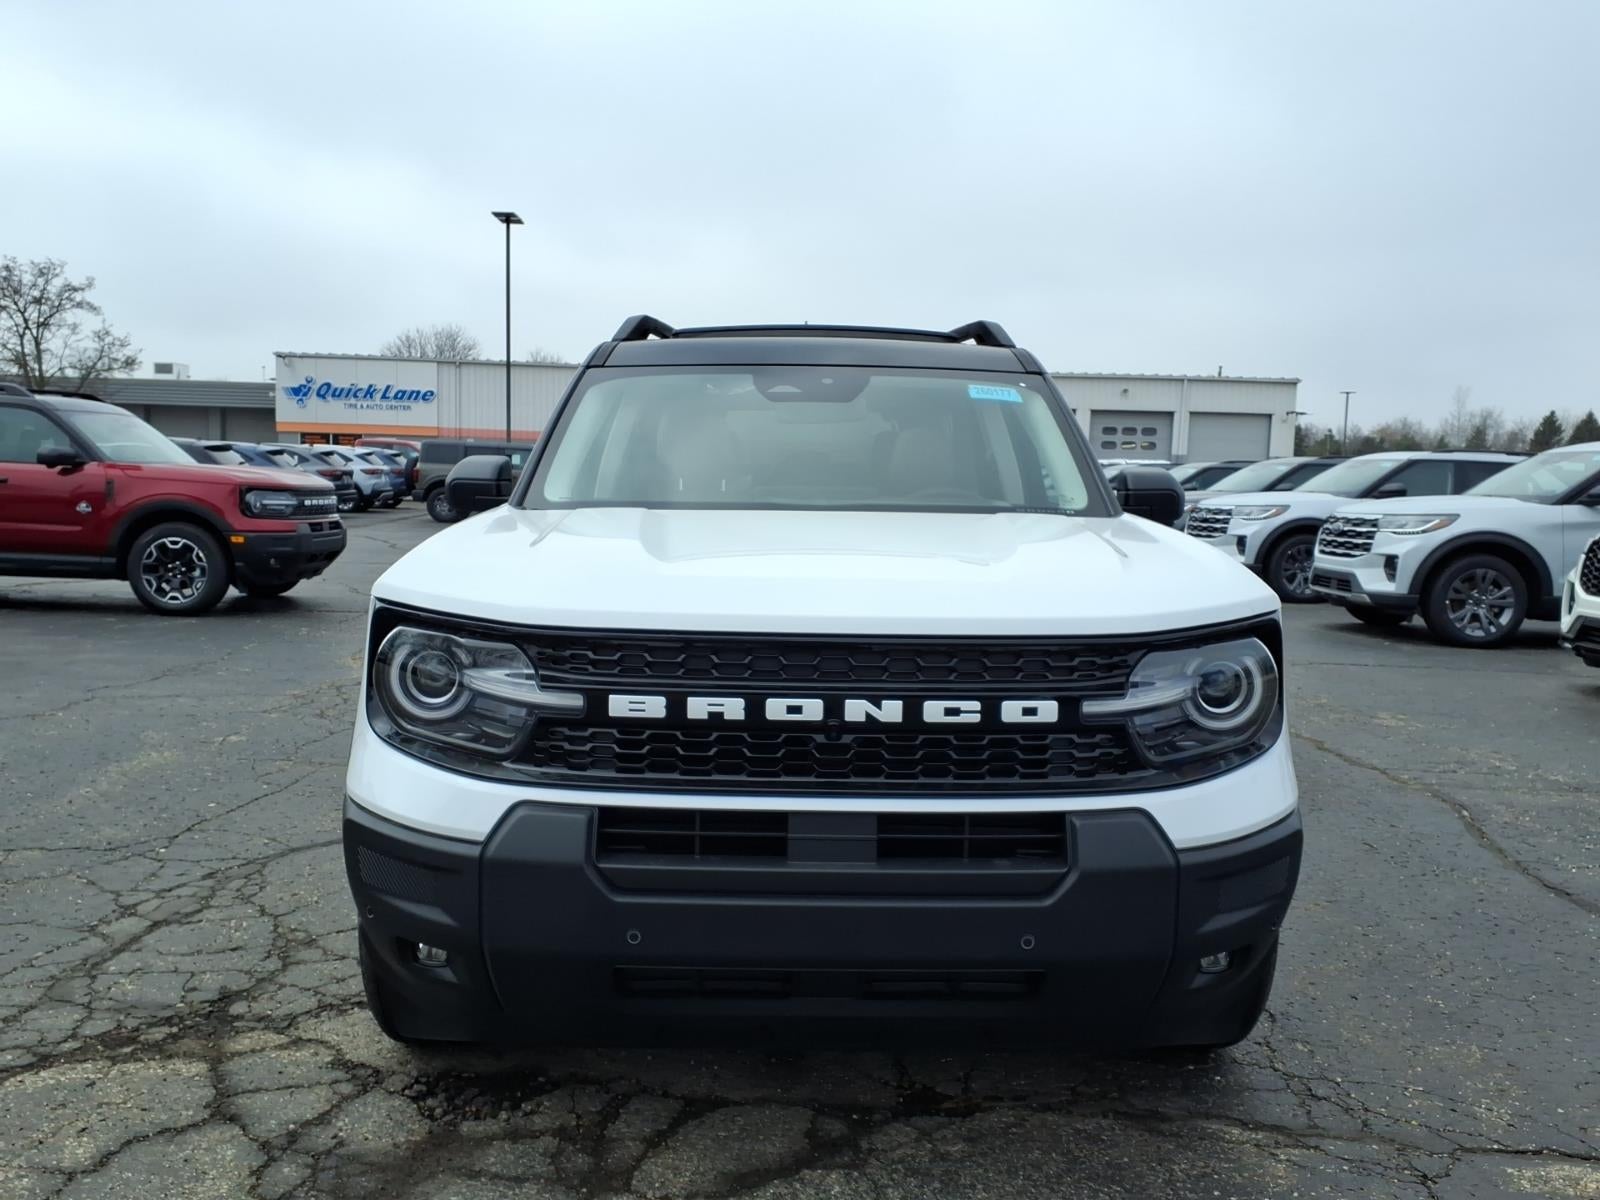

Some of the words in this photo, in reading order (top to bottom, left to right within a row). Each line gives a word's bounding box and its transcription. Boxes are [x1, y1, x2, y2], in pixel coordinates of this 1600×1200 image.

[316, 382, 377, 400] Quick
[380, 384, 436, 402] Lane
[343, 402, 358, 410] TIRE
[385, 403, 412, 411] CENTER
[608, 694, 1059, 723] BRONCO
